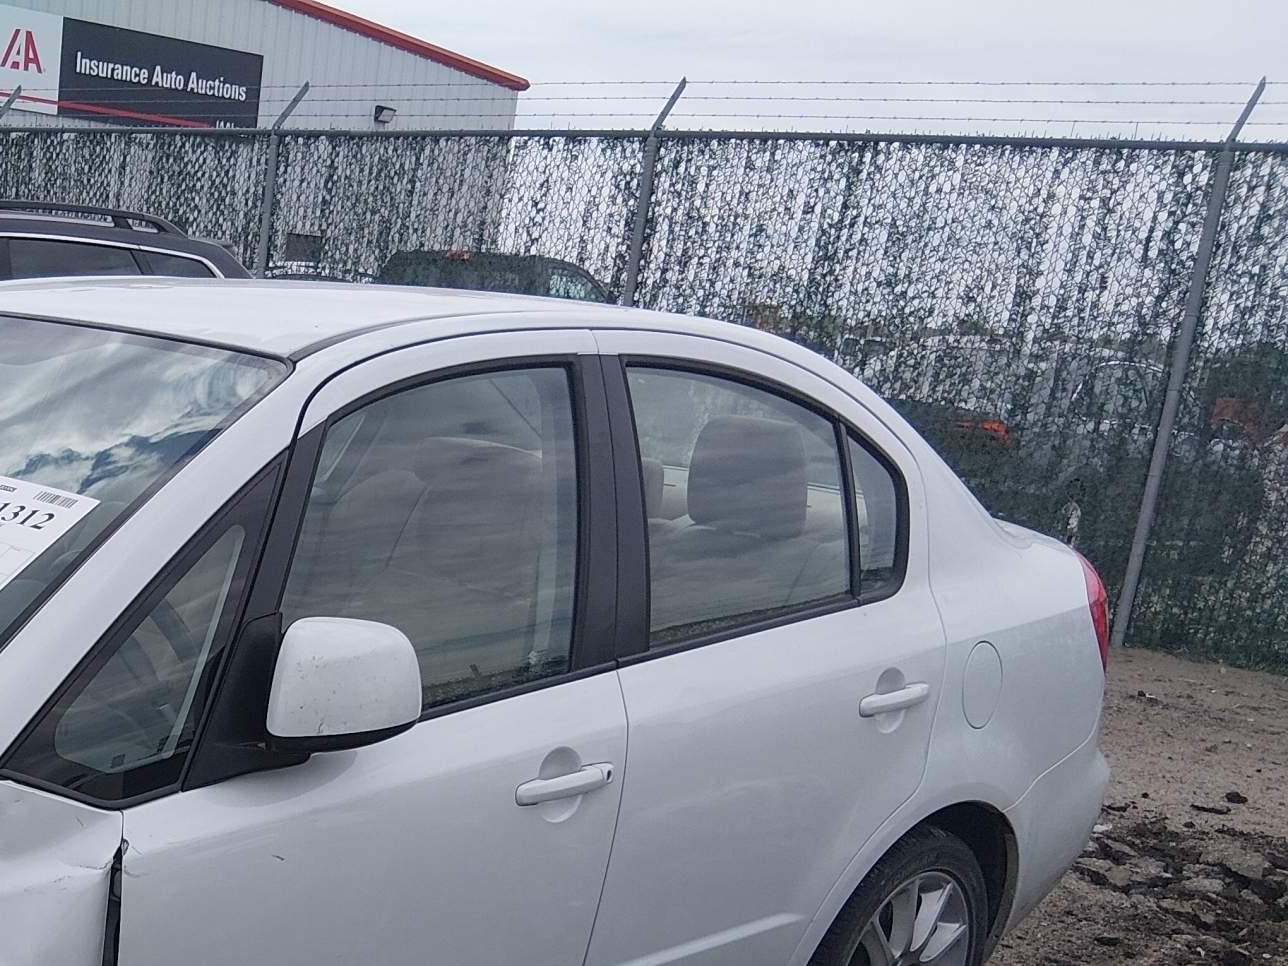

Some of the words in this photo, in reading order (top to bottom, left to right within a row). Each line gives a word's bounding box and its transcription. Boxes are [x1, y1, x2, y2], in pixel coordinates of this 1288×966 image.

[75, 51, 149, 84] Insurance
[151, 65, 185, 90] Auto
[186, 71, 247, 101] Auctions
